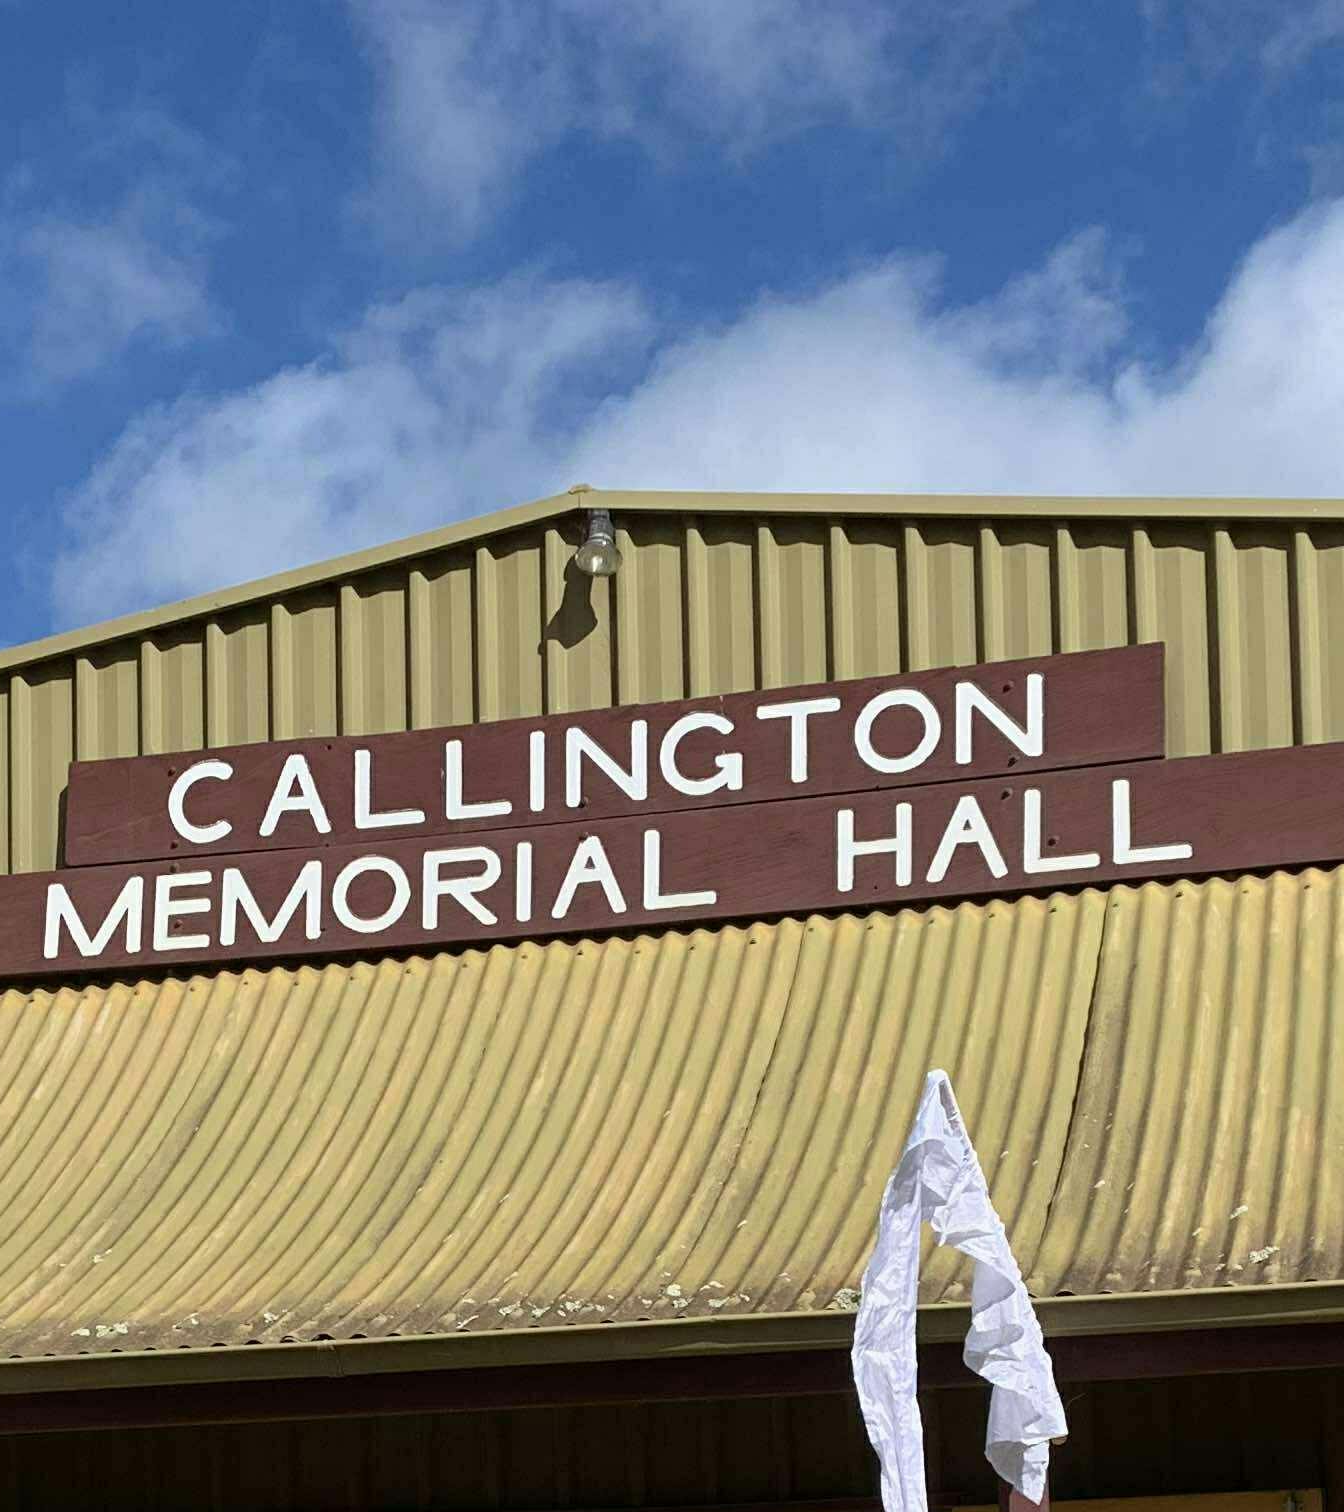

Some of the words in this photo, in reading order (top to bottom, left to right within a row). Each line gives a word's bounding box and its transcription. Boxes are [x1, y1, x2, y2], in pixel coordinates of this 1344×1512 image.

[168, 673, 1045, 844] CALLINGTON
[43, 827, 717, 959] MEMORIAL
[837, 779, 1193, 892] HALL
